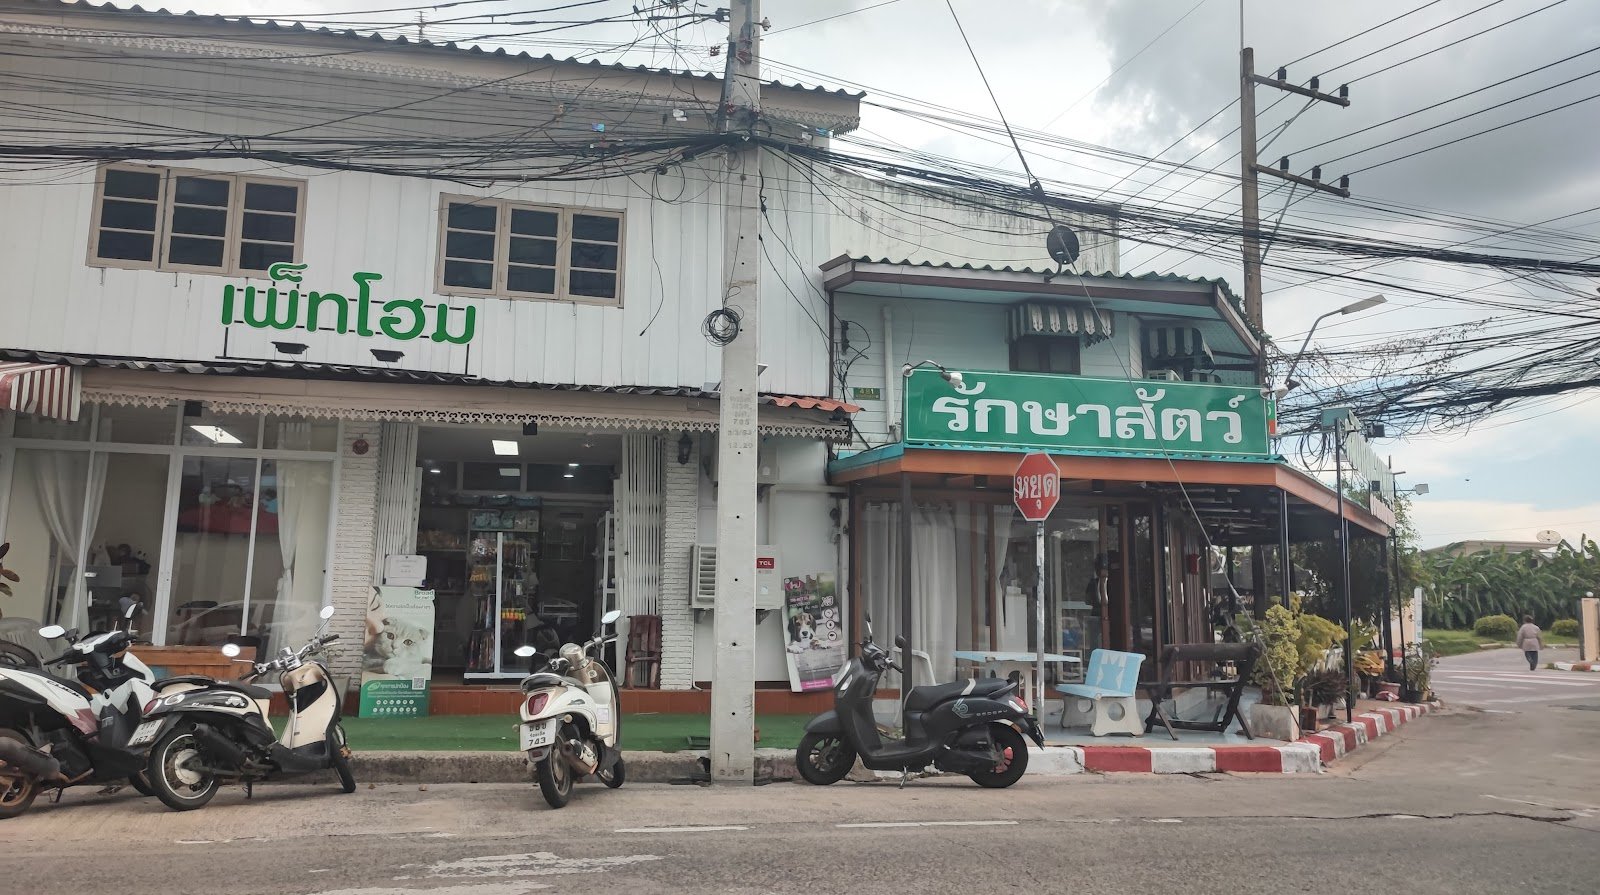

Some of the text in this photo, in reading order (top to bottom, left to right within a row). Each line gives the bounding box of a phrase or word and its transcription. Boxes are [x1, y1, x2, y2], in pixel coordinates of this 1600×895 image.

[222, 263, 476, 345] เพ็ทโฮม
[932, 380, 1245, 443] รักษาสัตว์
[1015, 473, 1056, 509] หยุด
[528, 737, 546, 747] 743
